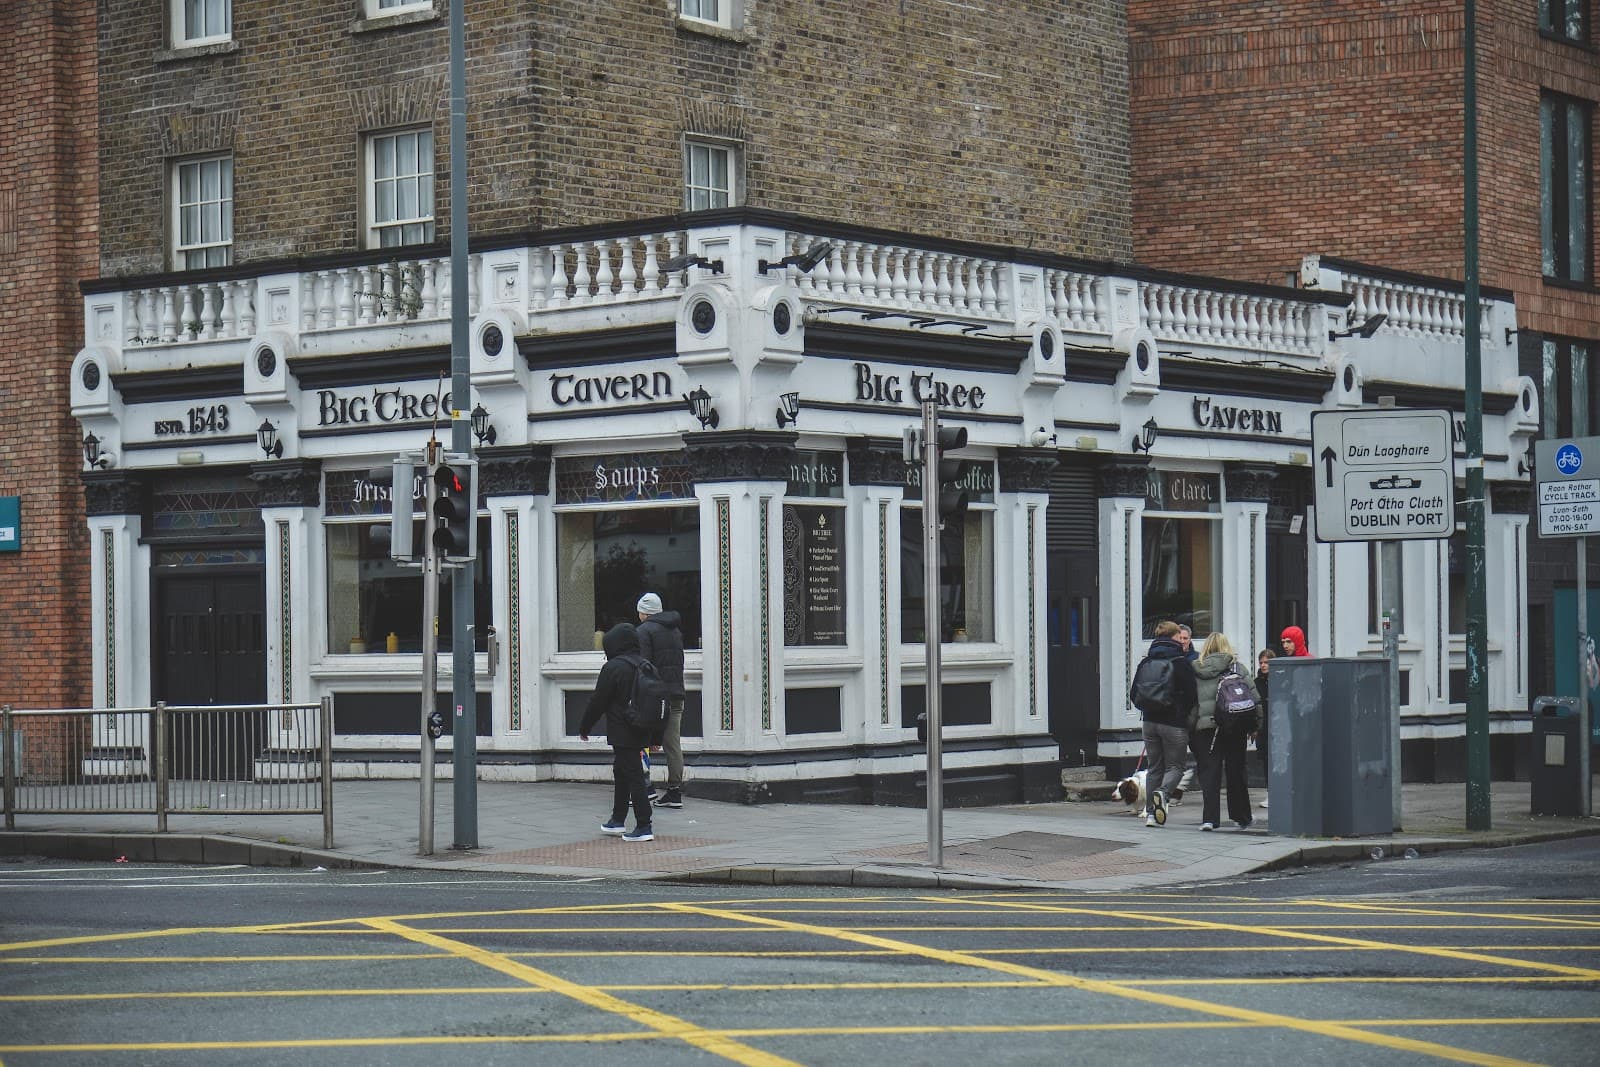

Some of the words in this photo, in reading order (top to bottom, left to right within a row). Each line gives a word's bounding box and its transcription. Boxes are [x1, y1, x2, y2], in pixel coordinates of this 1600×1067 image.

[187, 404, 229, 434] 1543
[1348, 445, 1370, 457] Dún
[1374, 443, 1430, 458] Laoghaire
[594, 464, 660, 495] Soups
[790, 463, 837, 484] nacks
[352, 479, 393, 503] Iris
[1171, 478, 1212, 500] Claret
[1544, 492, 1568, 501] CYCLE
[1570, 491, 1596, 500] TRACK
[1350, 498, 1374, 511] Port
[1409, 495, 1443, 510] Cliath
[1350, 513, 1400, 527] DUBLIN
[1407, 512, 1443, 526] PORT
[1553, 523, 1589, 532] MON-SAT
